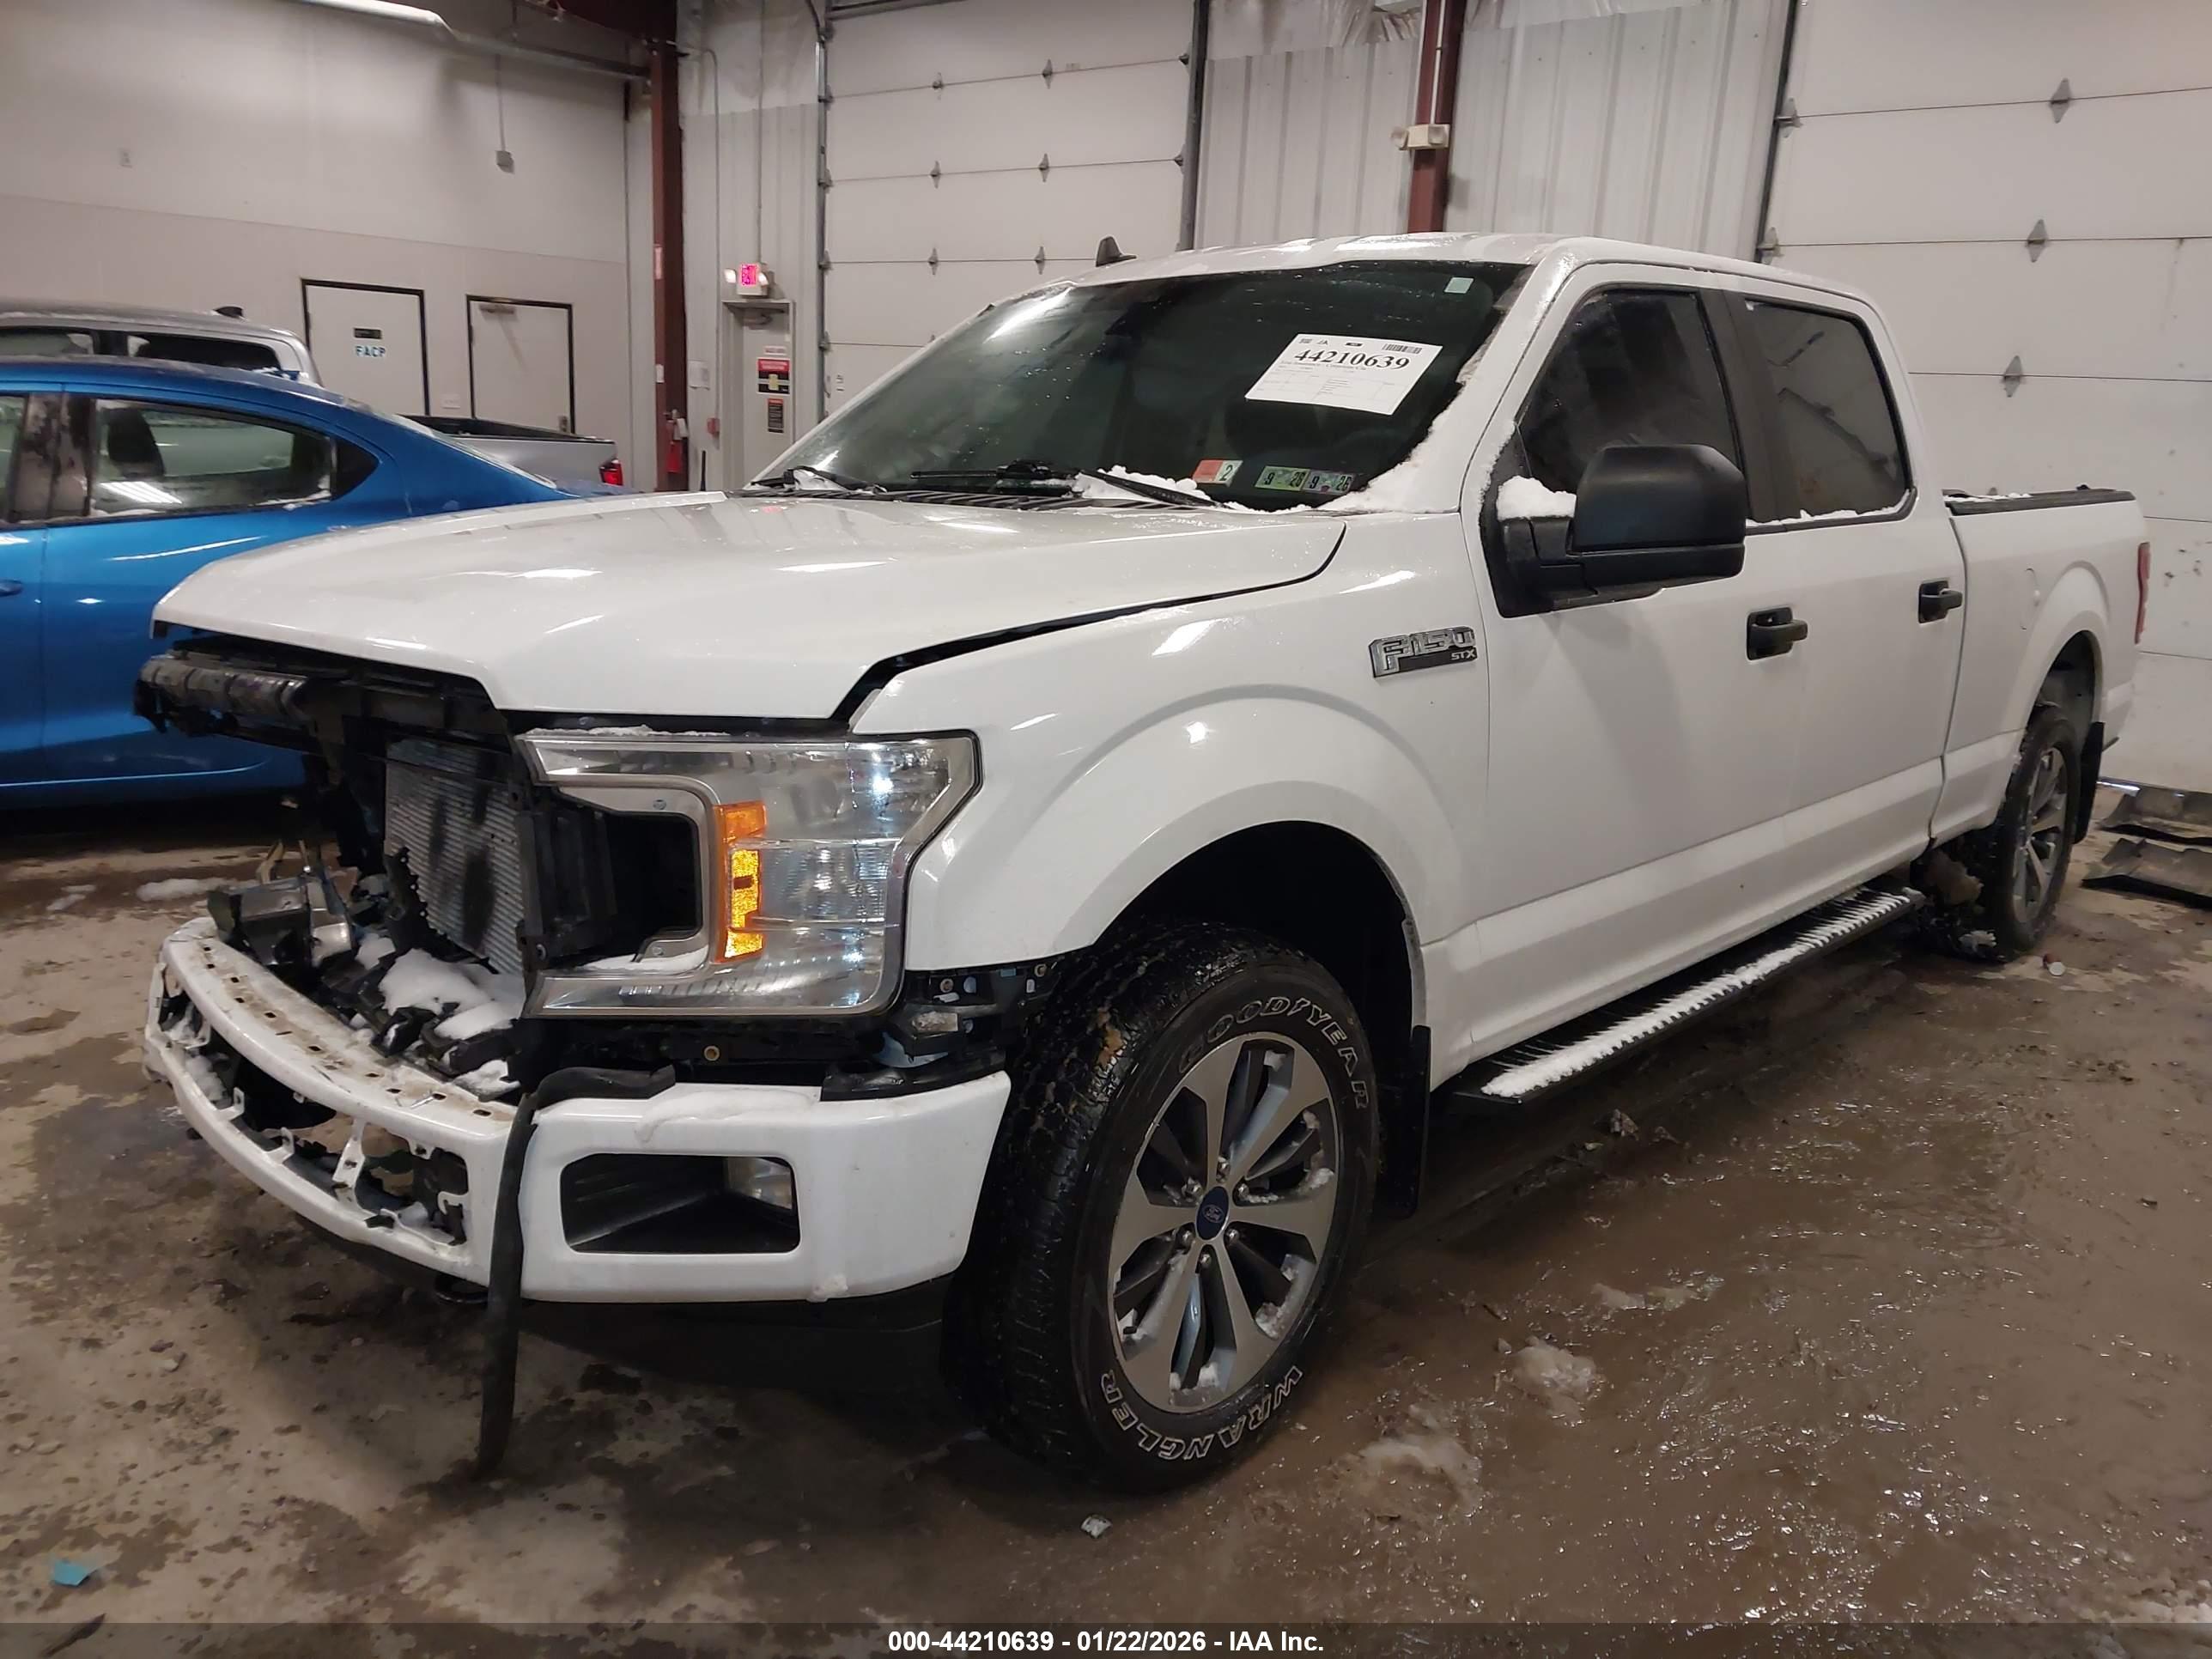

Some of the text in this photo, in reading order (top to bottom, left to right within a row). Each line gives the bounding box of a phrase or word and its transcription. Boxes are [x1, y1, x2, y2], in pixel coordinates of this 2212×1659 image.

[1294, 349, 1410, 370] 44210639
[1310, 476, 1320, 489] 9
[1451, 649, 1475, 660] STX
[1179, 996, 1369, 1109] GOODYEAR
[1101, 1365, 1304, 1461] WRANGLER
